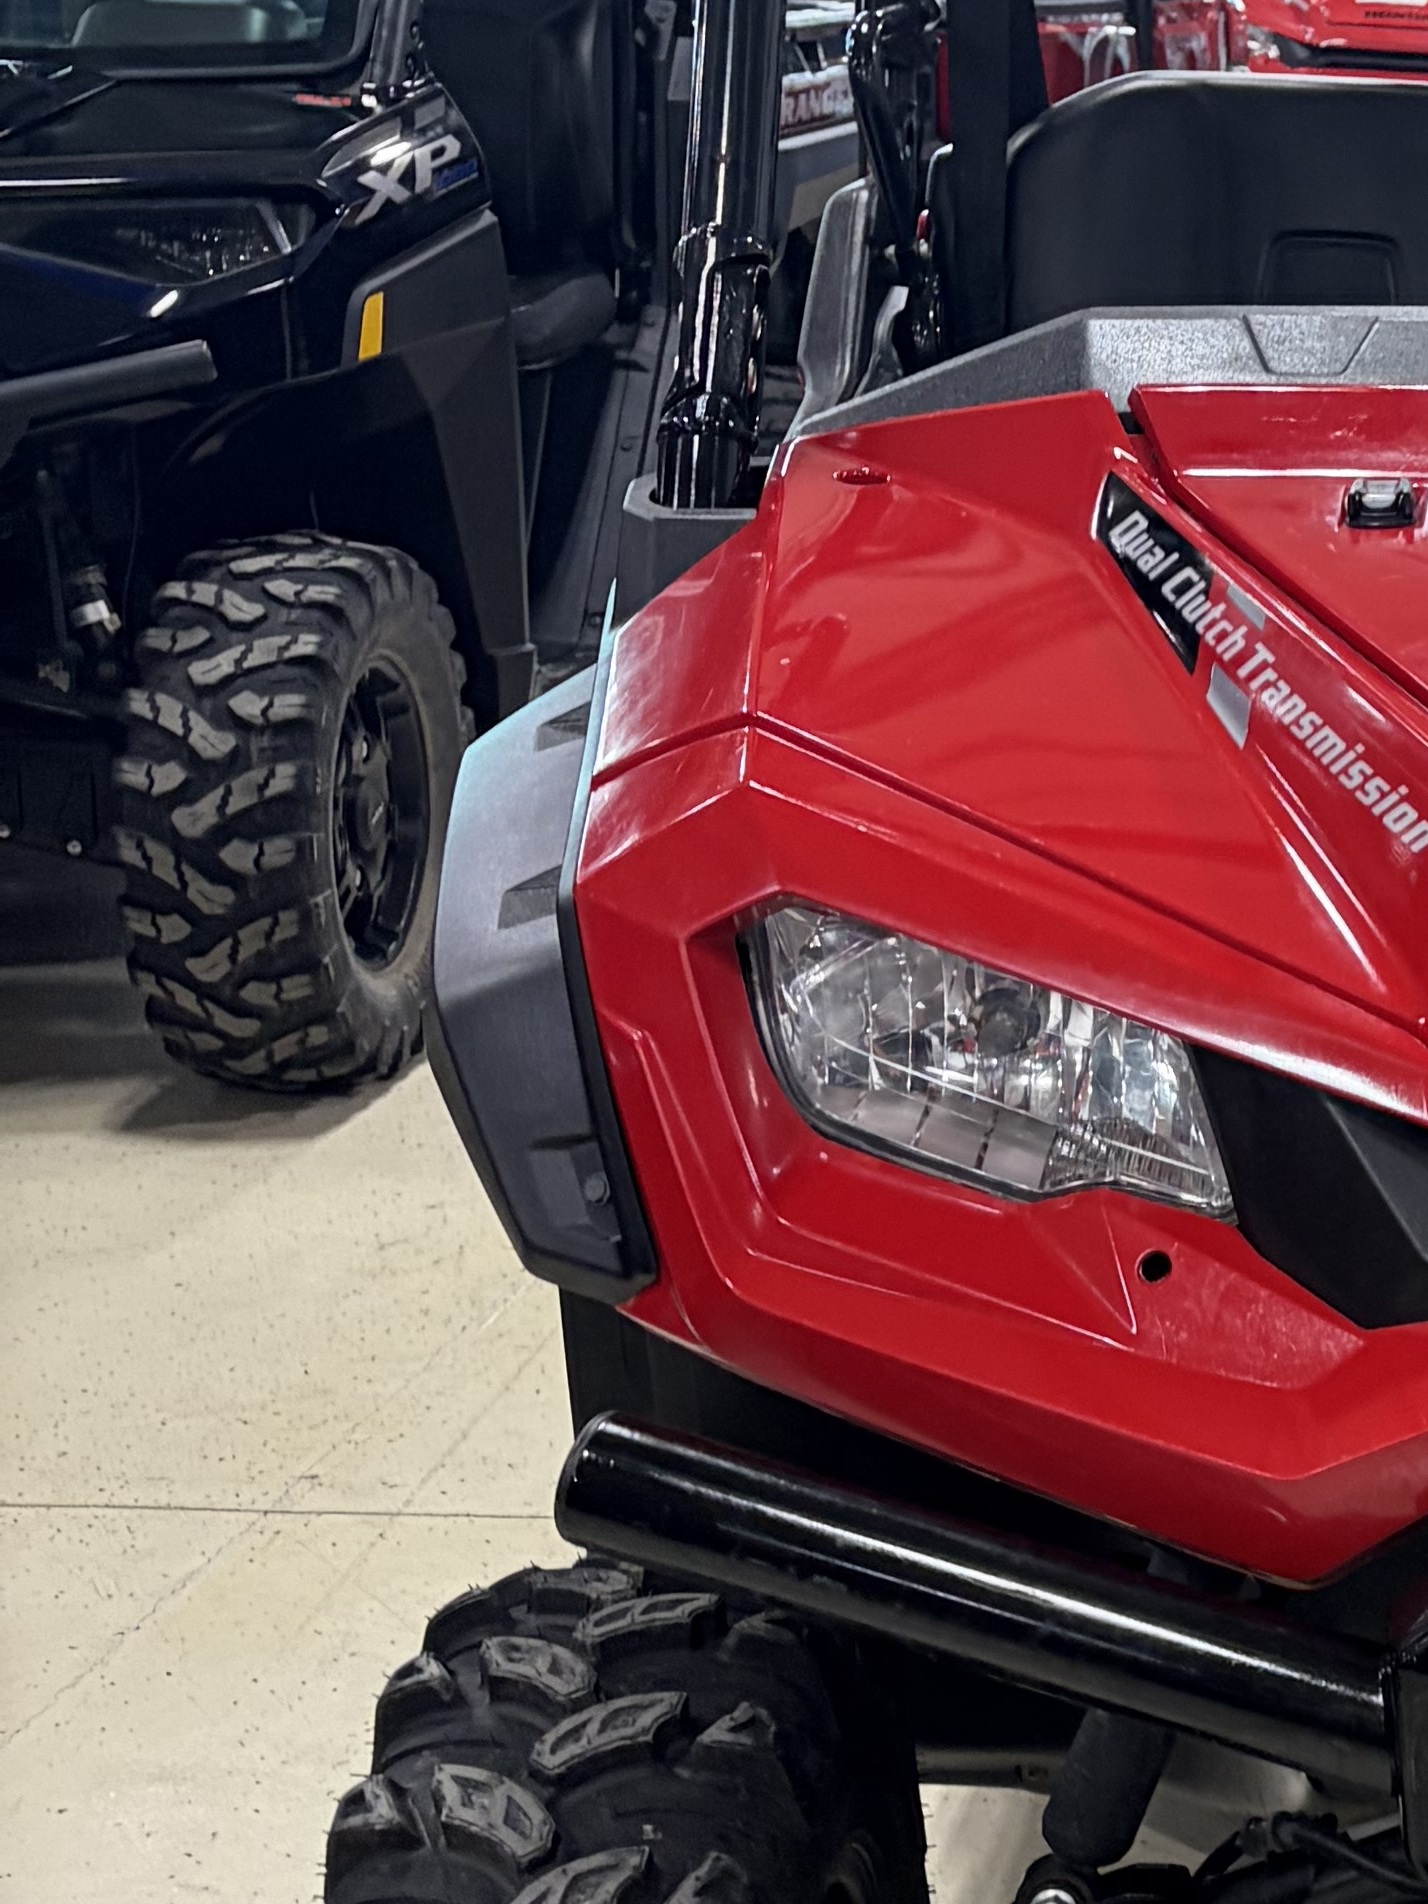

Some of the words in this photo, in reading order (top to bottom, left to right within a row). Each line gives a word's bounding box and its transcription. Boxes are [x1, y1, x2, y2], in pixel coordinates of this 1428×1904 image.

[355, 134, 461, 225] XP
[1108, 510, 1180, 582] Dual
[1161, 566, 1248, 662] Clutch
